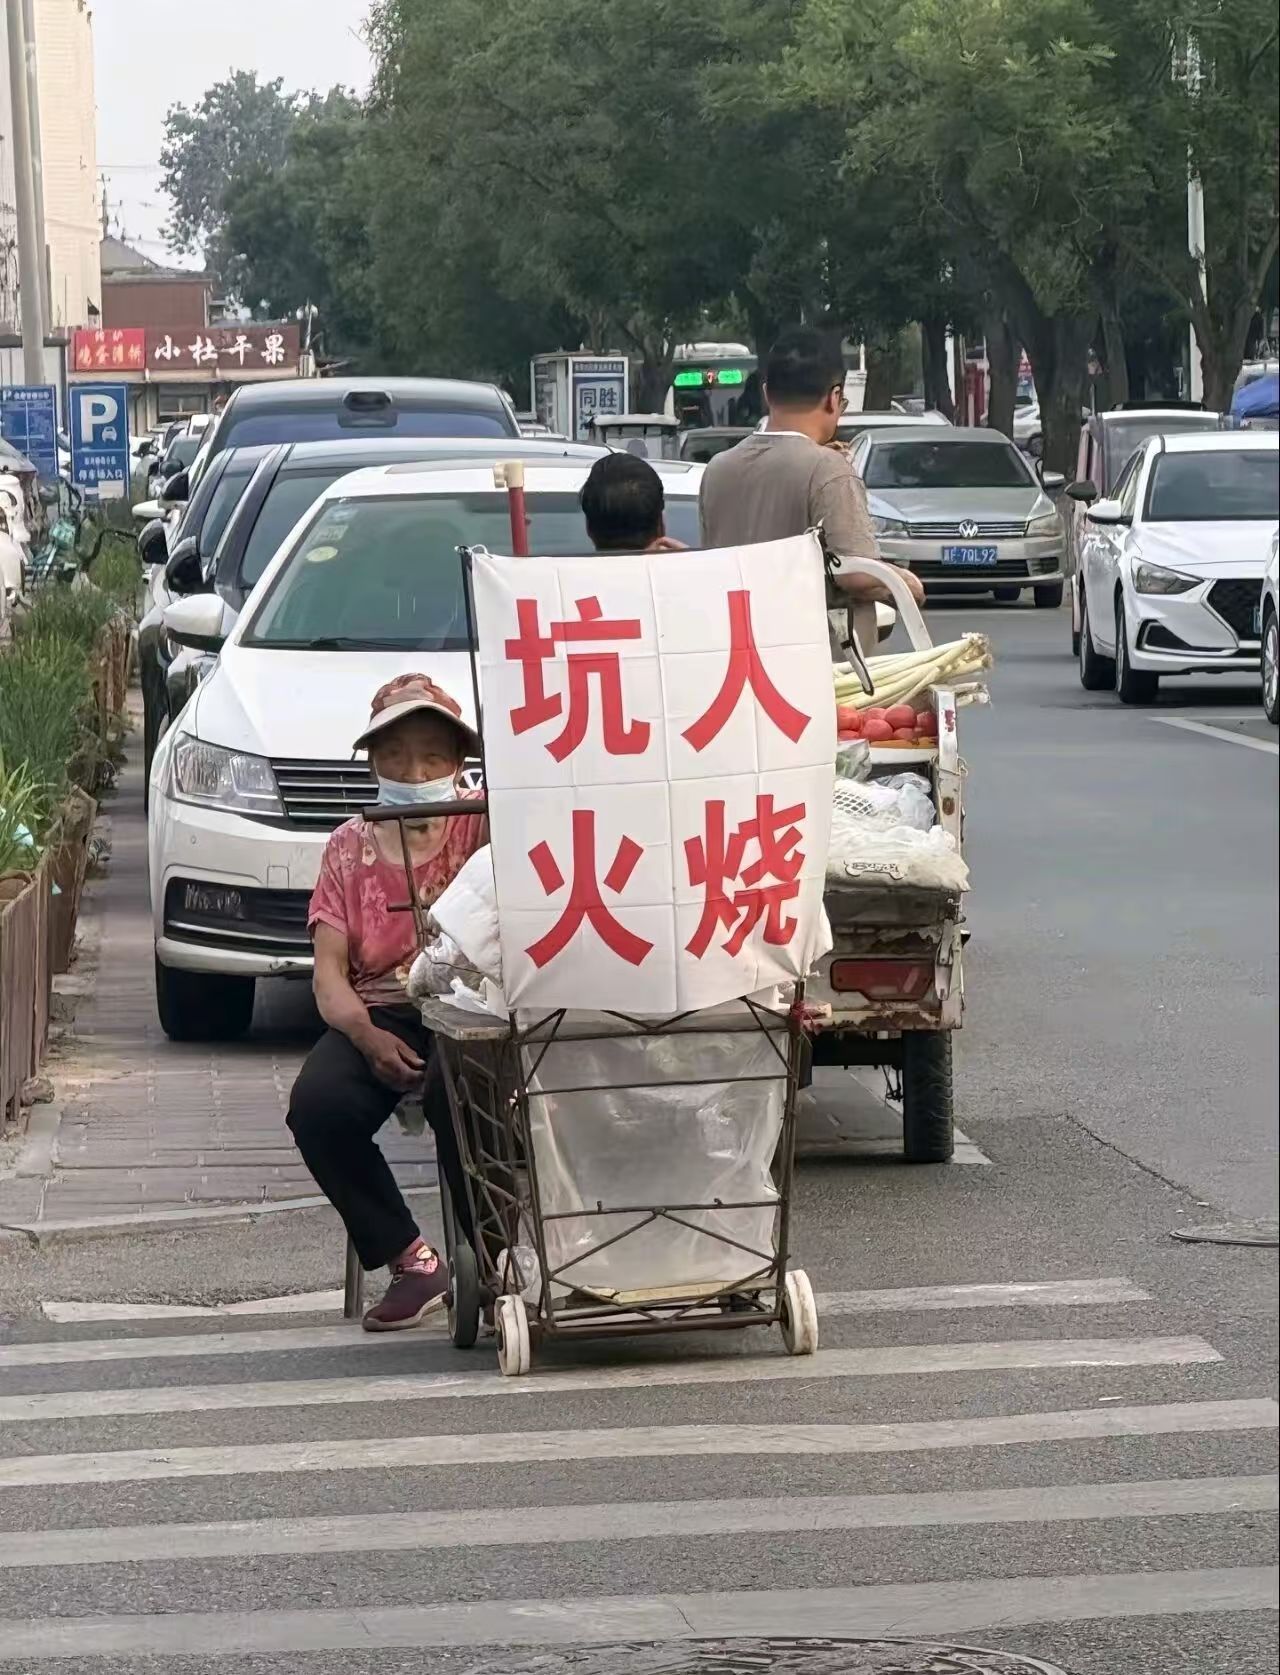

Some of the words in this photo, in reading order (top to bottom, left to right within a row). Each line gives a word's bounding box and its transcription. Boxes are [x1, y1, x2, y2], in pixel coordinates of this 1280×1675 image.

[154, 334, 285, 366] 小杜干果
[80, 394, 118, 443] P
[504, 588, 813, 765] 坑人
[523, 793, 806, 970] 火烧
